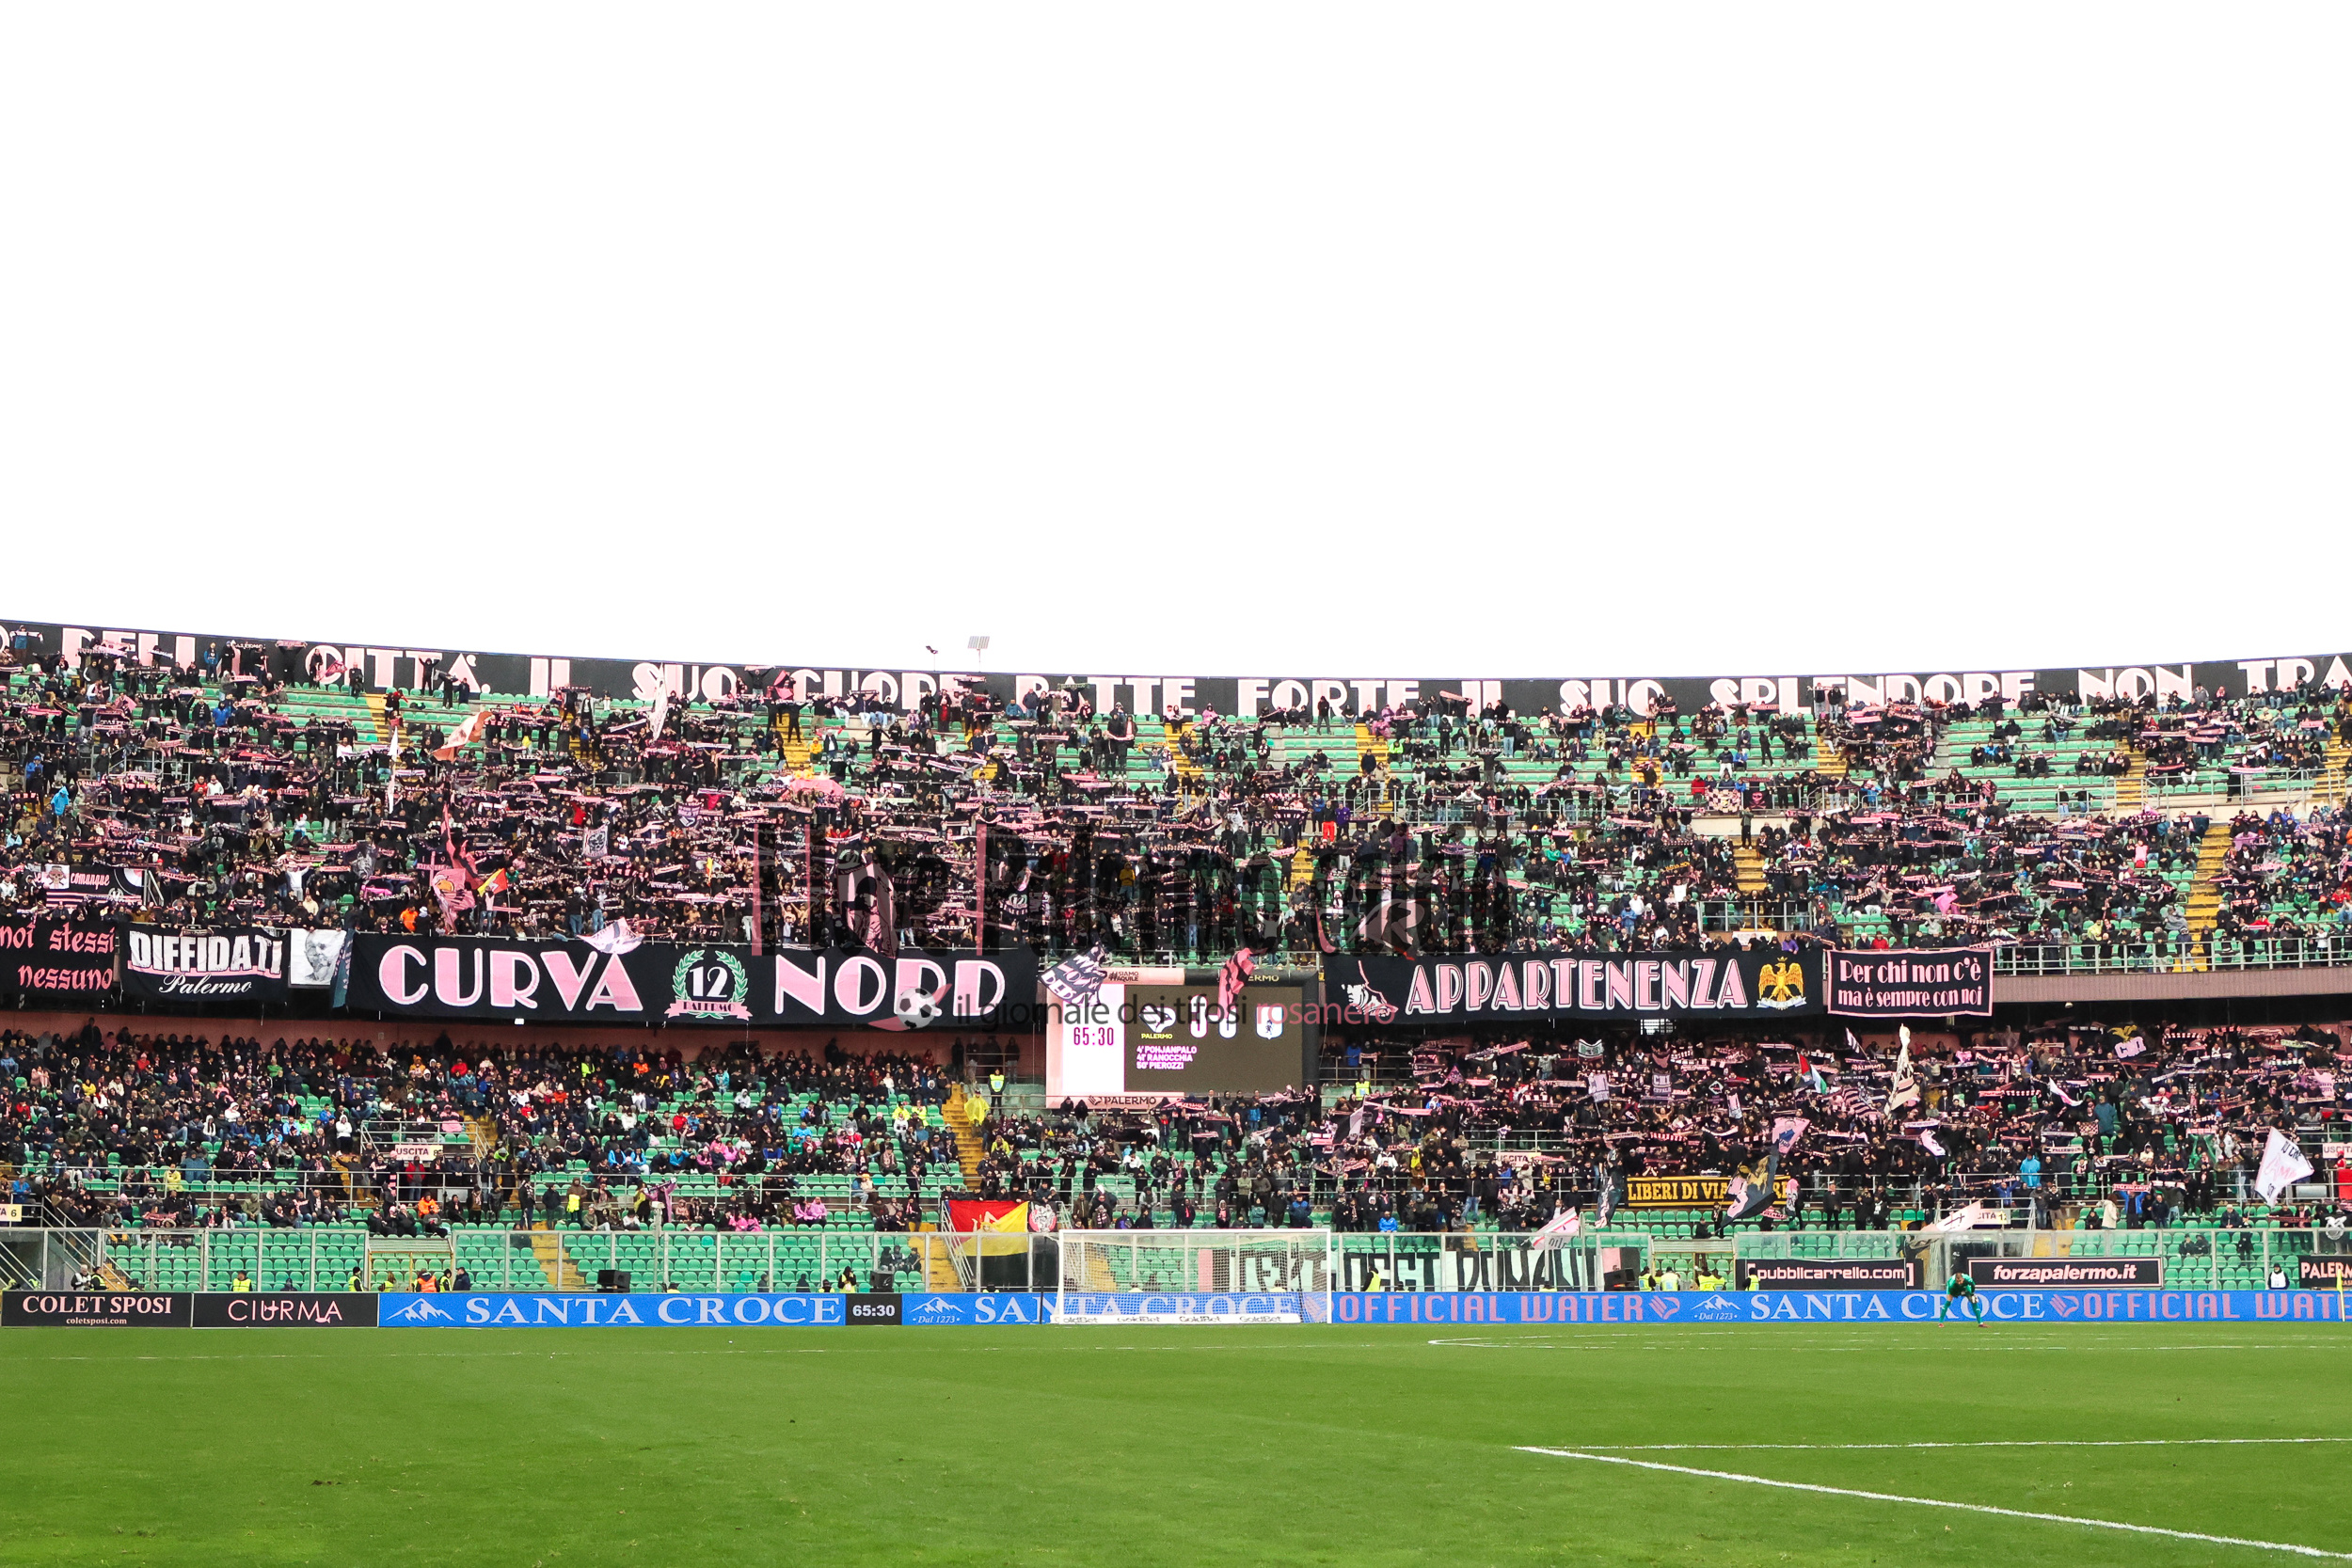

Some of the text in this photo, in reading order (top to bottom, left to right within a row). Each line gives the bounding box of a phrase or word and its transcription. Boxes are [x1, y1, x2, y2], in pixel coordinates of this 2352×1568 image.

[632, 661, 738, 702] SUO
[1237, 679, 1420, 720] FORTE
[1560, 679, 1665, 718] SUO
[2078, 663, 2193, 707] NON
[49, 927, 115, 954] stessi
[129, 930, 283, 974] DIFFIDATI
[18, 964, 113, 990] nessuno
[378, 943, 645, 1012] CURVA
[1839, 959, 1874, 984] Per
[1878, 958, 1908, 983] chi
[1913, 964, 1948, 983] non
[158, 974, 252, 995] Palermo
[689, 966, 729, 999] 12
[776, 954, 1007, 1017] NORD
[1406, 958, 1748, 1012] APPARTENENZA
[1837, 986, 1982, 1011] ma è sempre con noi
[1073, 1027, 1114, 1046] 65:30
[1145, 1045, 1197, 1054] POHJANPALO
[1148, 1053, 1193, 1062] RANOCCHIA
[1149, 1061, 1184, 1069] PIEROZZI
[1104, 1095, 1157, 1105] PALERMO
[395, 1147, 430, 1157] USCITA
[1628, 1183, 1677, 1202] LIBERI
[1681, 1183, 1697, 1202] DI
[10, 1209, 17, 1218] 6
[1993, 1263, 2137, 1283] forzapalermo.it
[23, 1295, 173, 1315] COLET SPOSI
[228, 1300, 342, 1322] CIURMA
[465, 1297, 842, 1325] SANTA CROCE
[851, 1304, 895, 1317] 65:30
[975, 1296, 1296, 1324] SANTA CROCE
[1339, 1294, 1645, 1322] OFFICIAL WATER
[1751, 1292, 2045, 1320] SANTA CROCE
[2084, 1293, 2241, 1318] OFFICIAL
[66, 1317, 128, 1326] coletsposi.com
[917, 1314, 957, 1324] Dal 1273
[1238, 1314, 1283, 1324] GoldBet
[1699, 1311, 1735, 1321] Dal 1273
